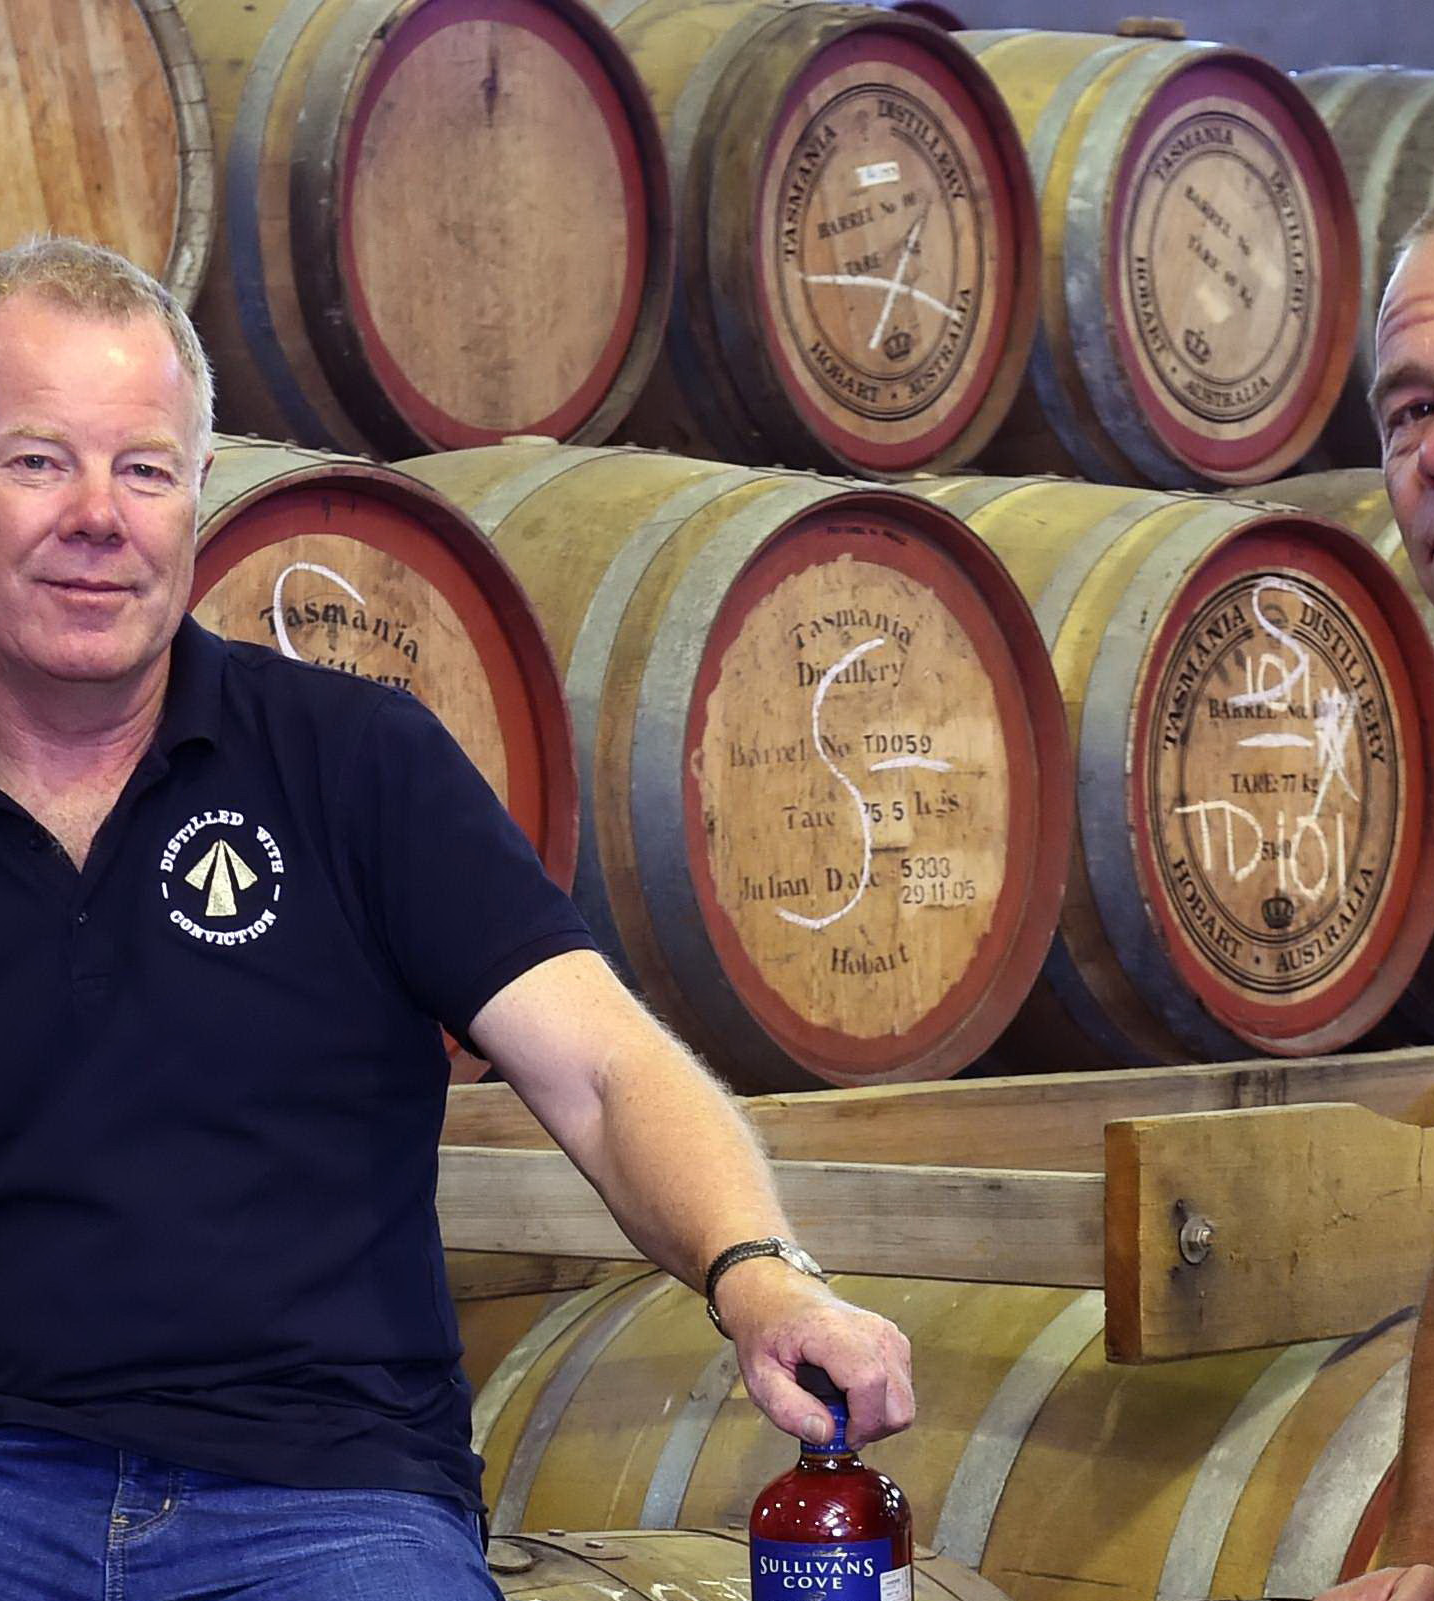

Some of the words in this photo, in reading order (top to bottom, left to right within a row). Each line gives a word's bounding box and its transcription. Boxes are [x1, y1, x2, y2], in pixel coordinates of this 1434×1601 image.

[784, 124, 837, 262] TASMANIA
[259, 598, 420, 664] Tasmania
[789, 608, 912, 655] Tasmania
[1163, 602, 1247, 752] TASMANIA
[1300, 605, 1385, 764] DISTILLERY
[160, 809, 245, 873] DISTILLED
[255, 825, 285, 874] WITH
[169, 908, 277, 946] CONVICTION
[1172, 857, 1242, 960] HOBART
[1275, 866, 1376, 973] AUSTRALIA
[831, 942, 911, 976] Hobart
[760, 1555, 875, 1577] SULLIVANS
[783, 1576, 844, 1590] COVE
